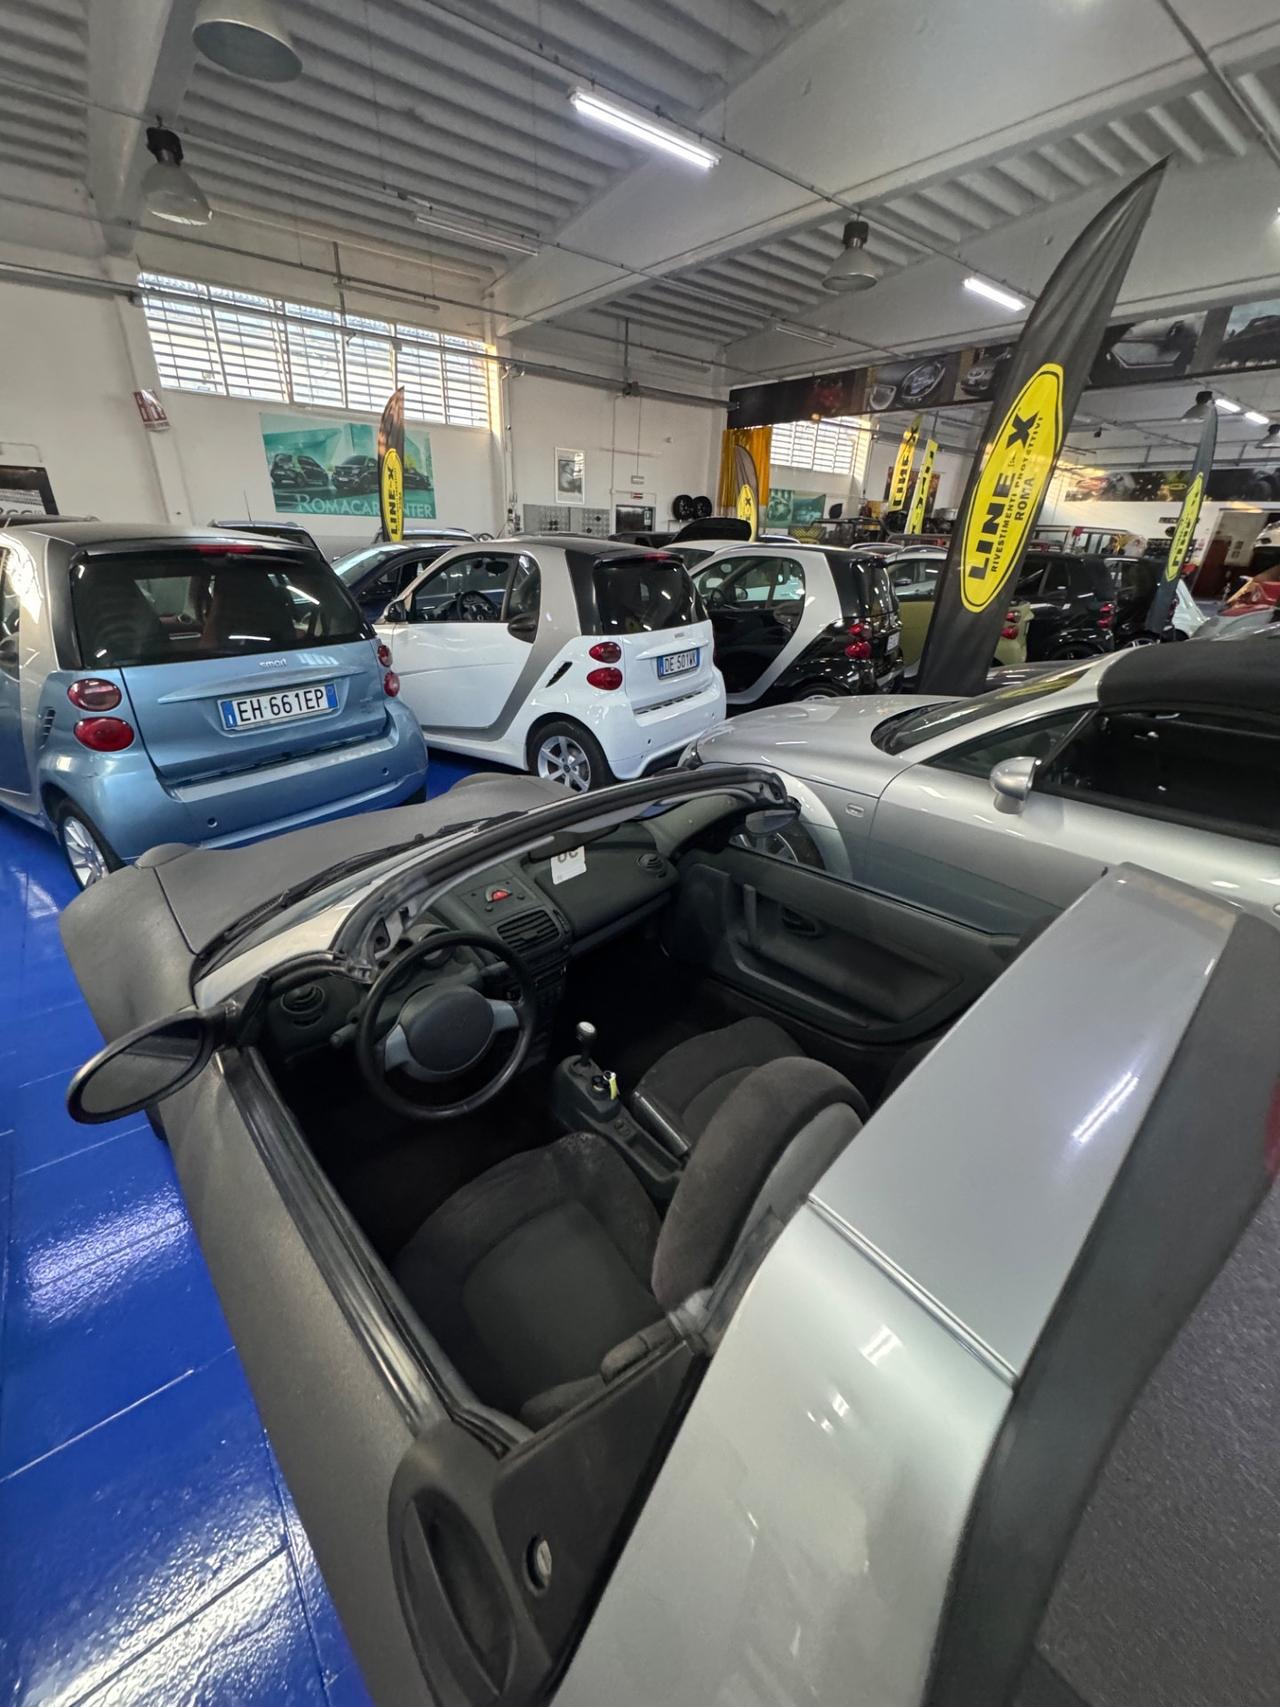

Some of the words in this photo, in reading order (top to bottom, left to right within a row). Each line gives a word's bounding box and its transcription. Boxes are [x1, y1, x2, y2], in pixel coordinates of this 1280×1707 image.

[991, 493, 1017, 572] RIVESTIMENTI
[1014, 417, 1043, 489] PROTETTIVI
[1014, 477, 1035, 521] ROMA
[664, 656, 674, 673] DE
[237, 698, 264, 722] EH
[269, 688, 324, 716] 661EP
